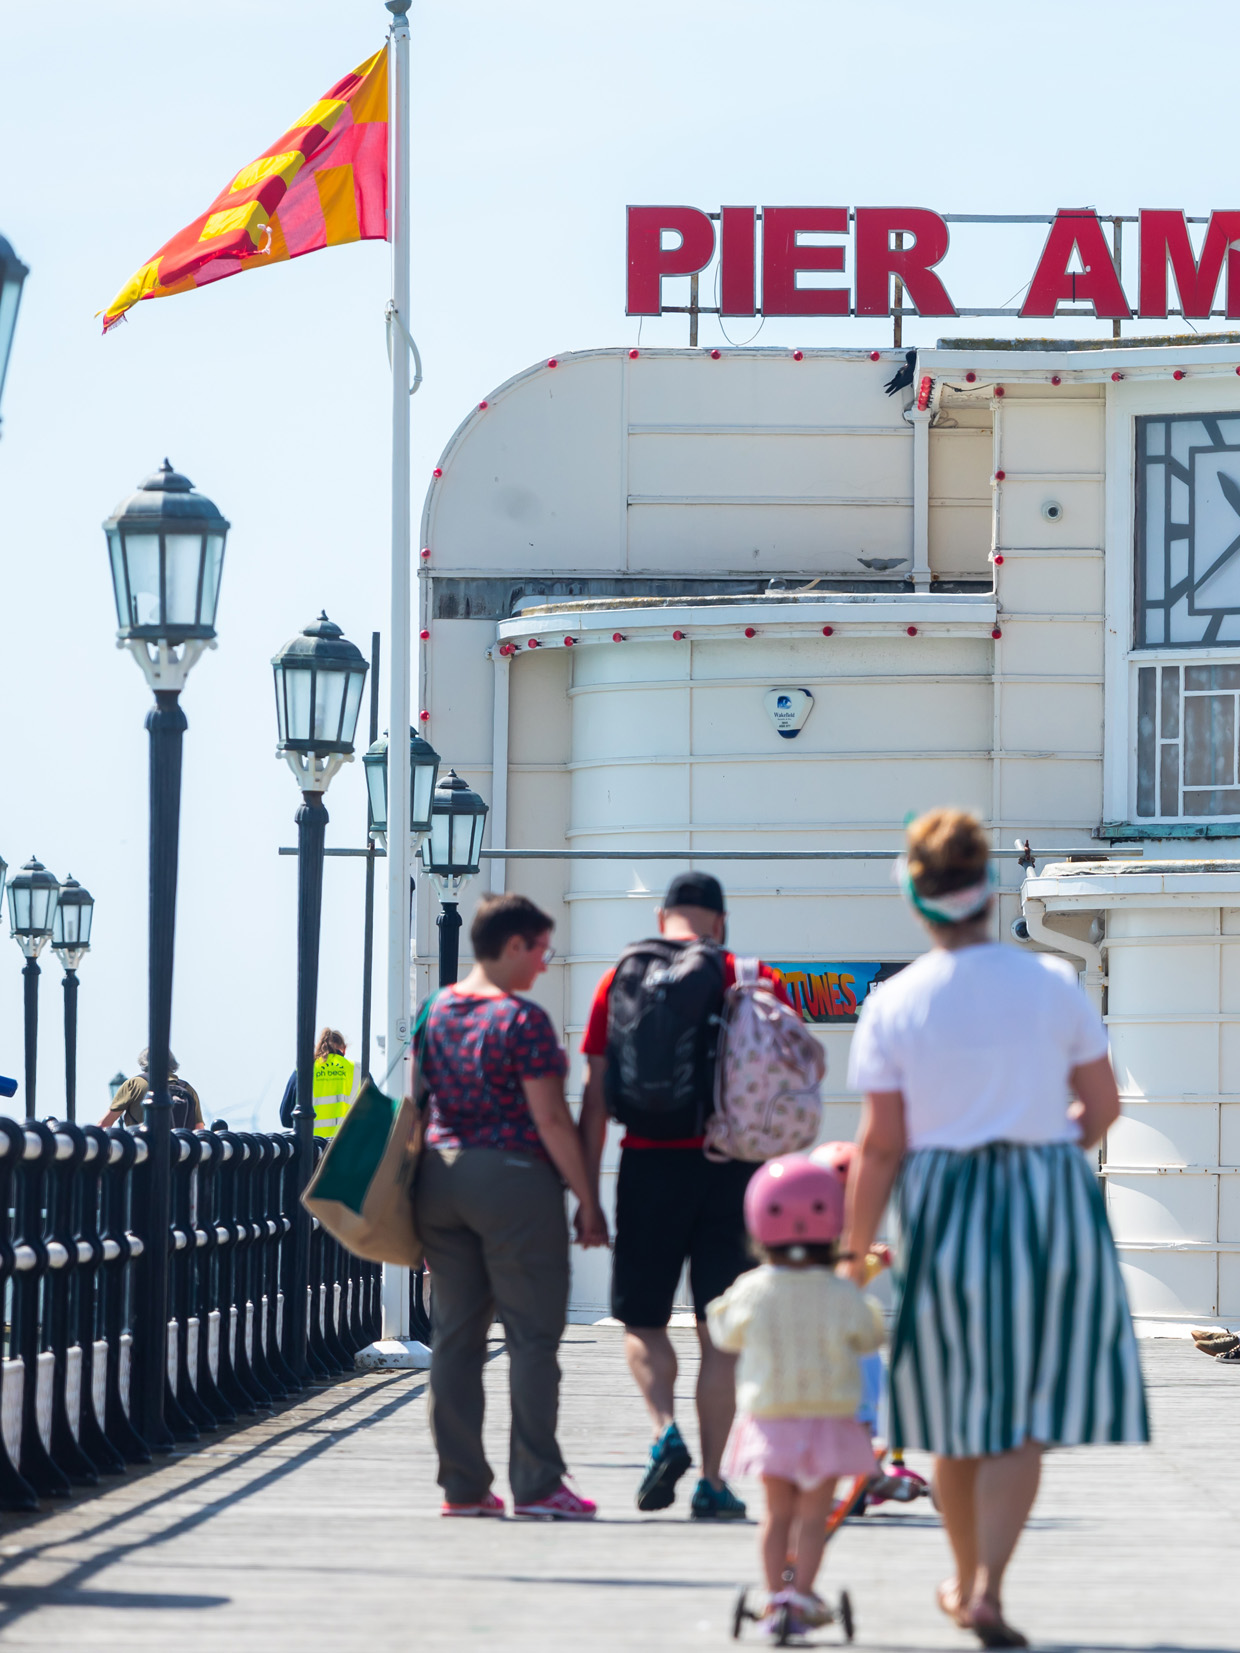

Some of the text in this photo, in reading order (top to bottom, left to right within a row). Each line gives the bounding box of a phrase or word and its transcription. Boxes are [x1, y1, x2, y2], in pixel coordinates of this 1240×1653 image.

[626, 205, 960, 317] PIER
[773, 967, 857, 1018] TUNES
[316, 1070, 326, 1078] ph
